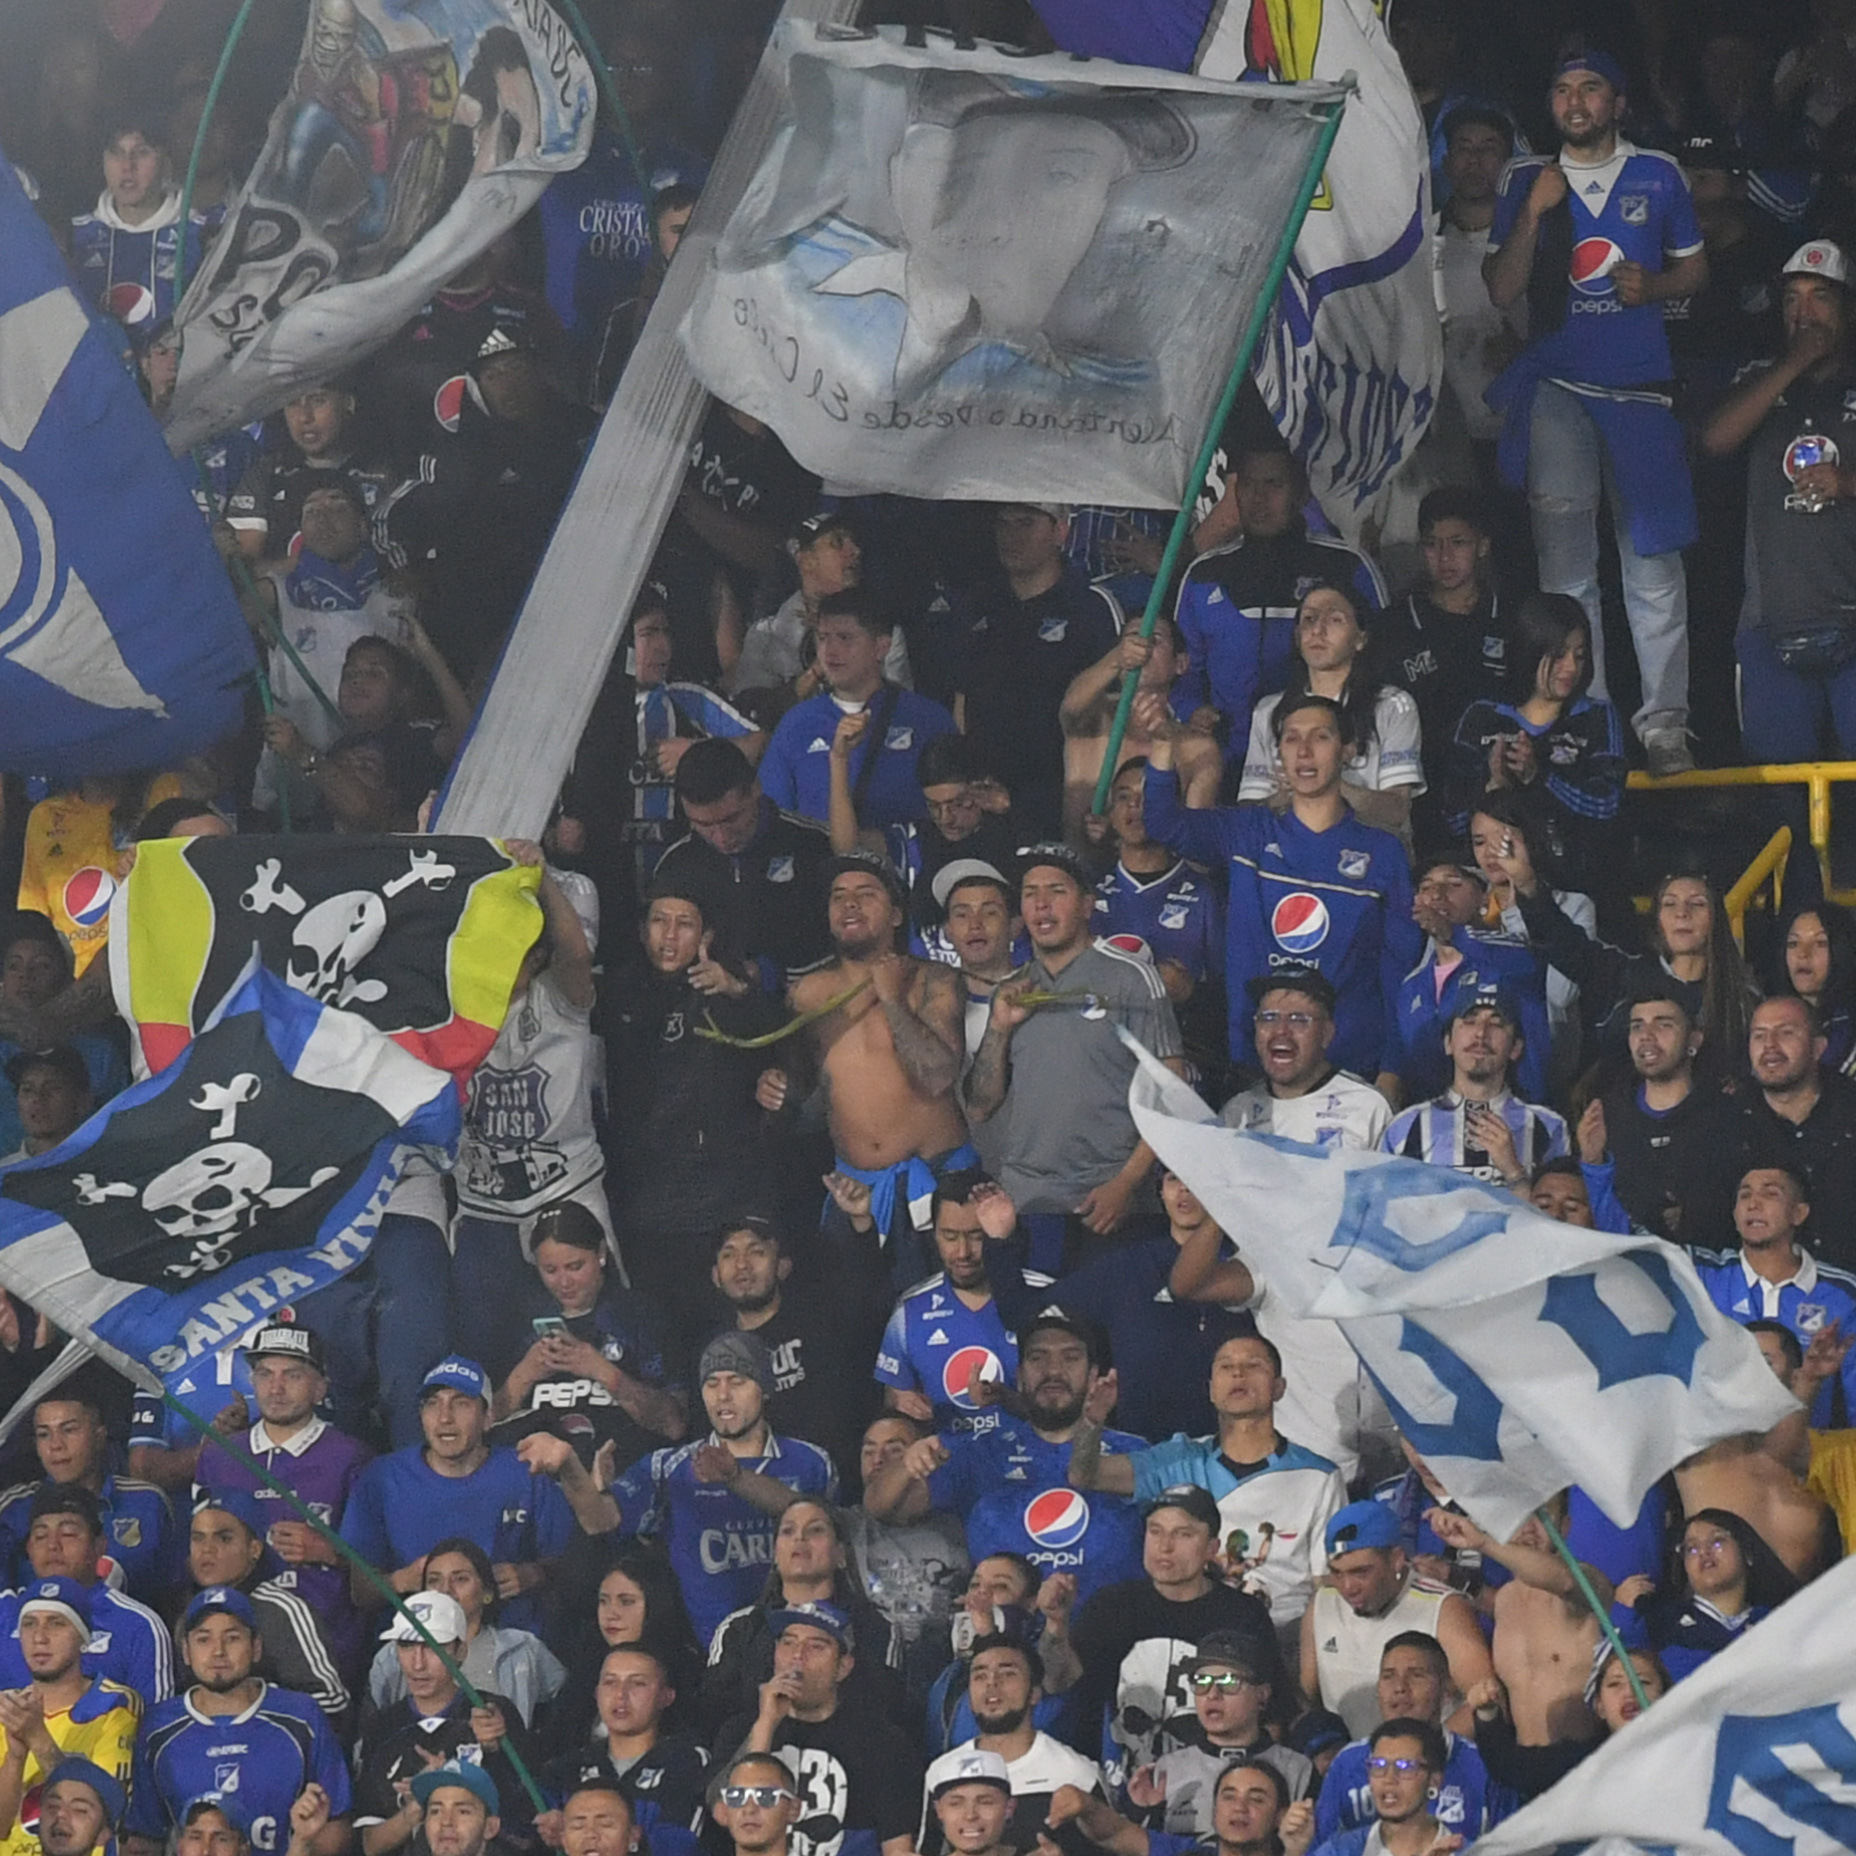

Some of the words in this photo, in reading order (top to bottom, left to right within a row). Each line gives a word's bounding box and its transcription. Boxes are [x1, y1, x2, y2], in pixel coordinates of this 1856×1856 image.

[589, 232, 641, 259] ORO
[485, 1081, 531, 1107] SAN
[148, 1264, 315, 1376] SANTA
[952, 1411, 1002, 1434] pepsi
